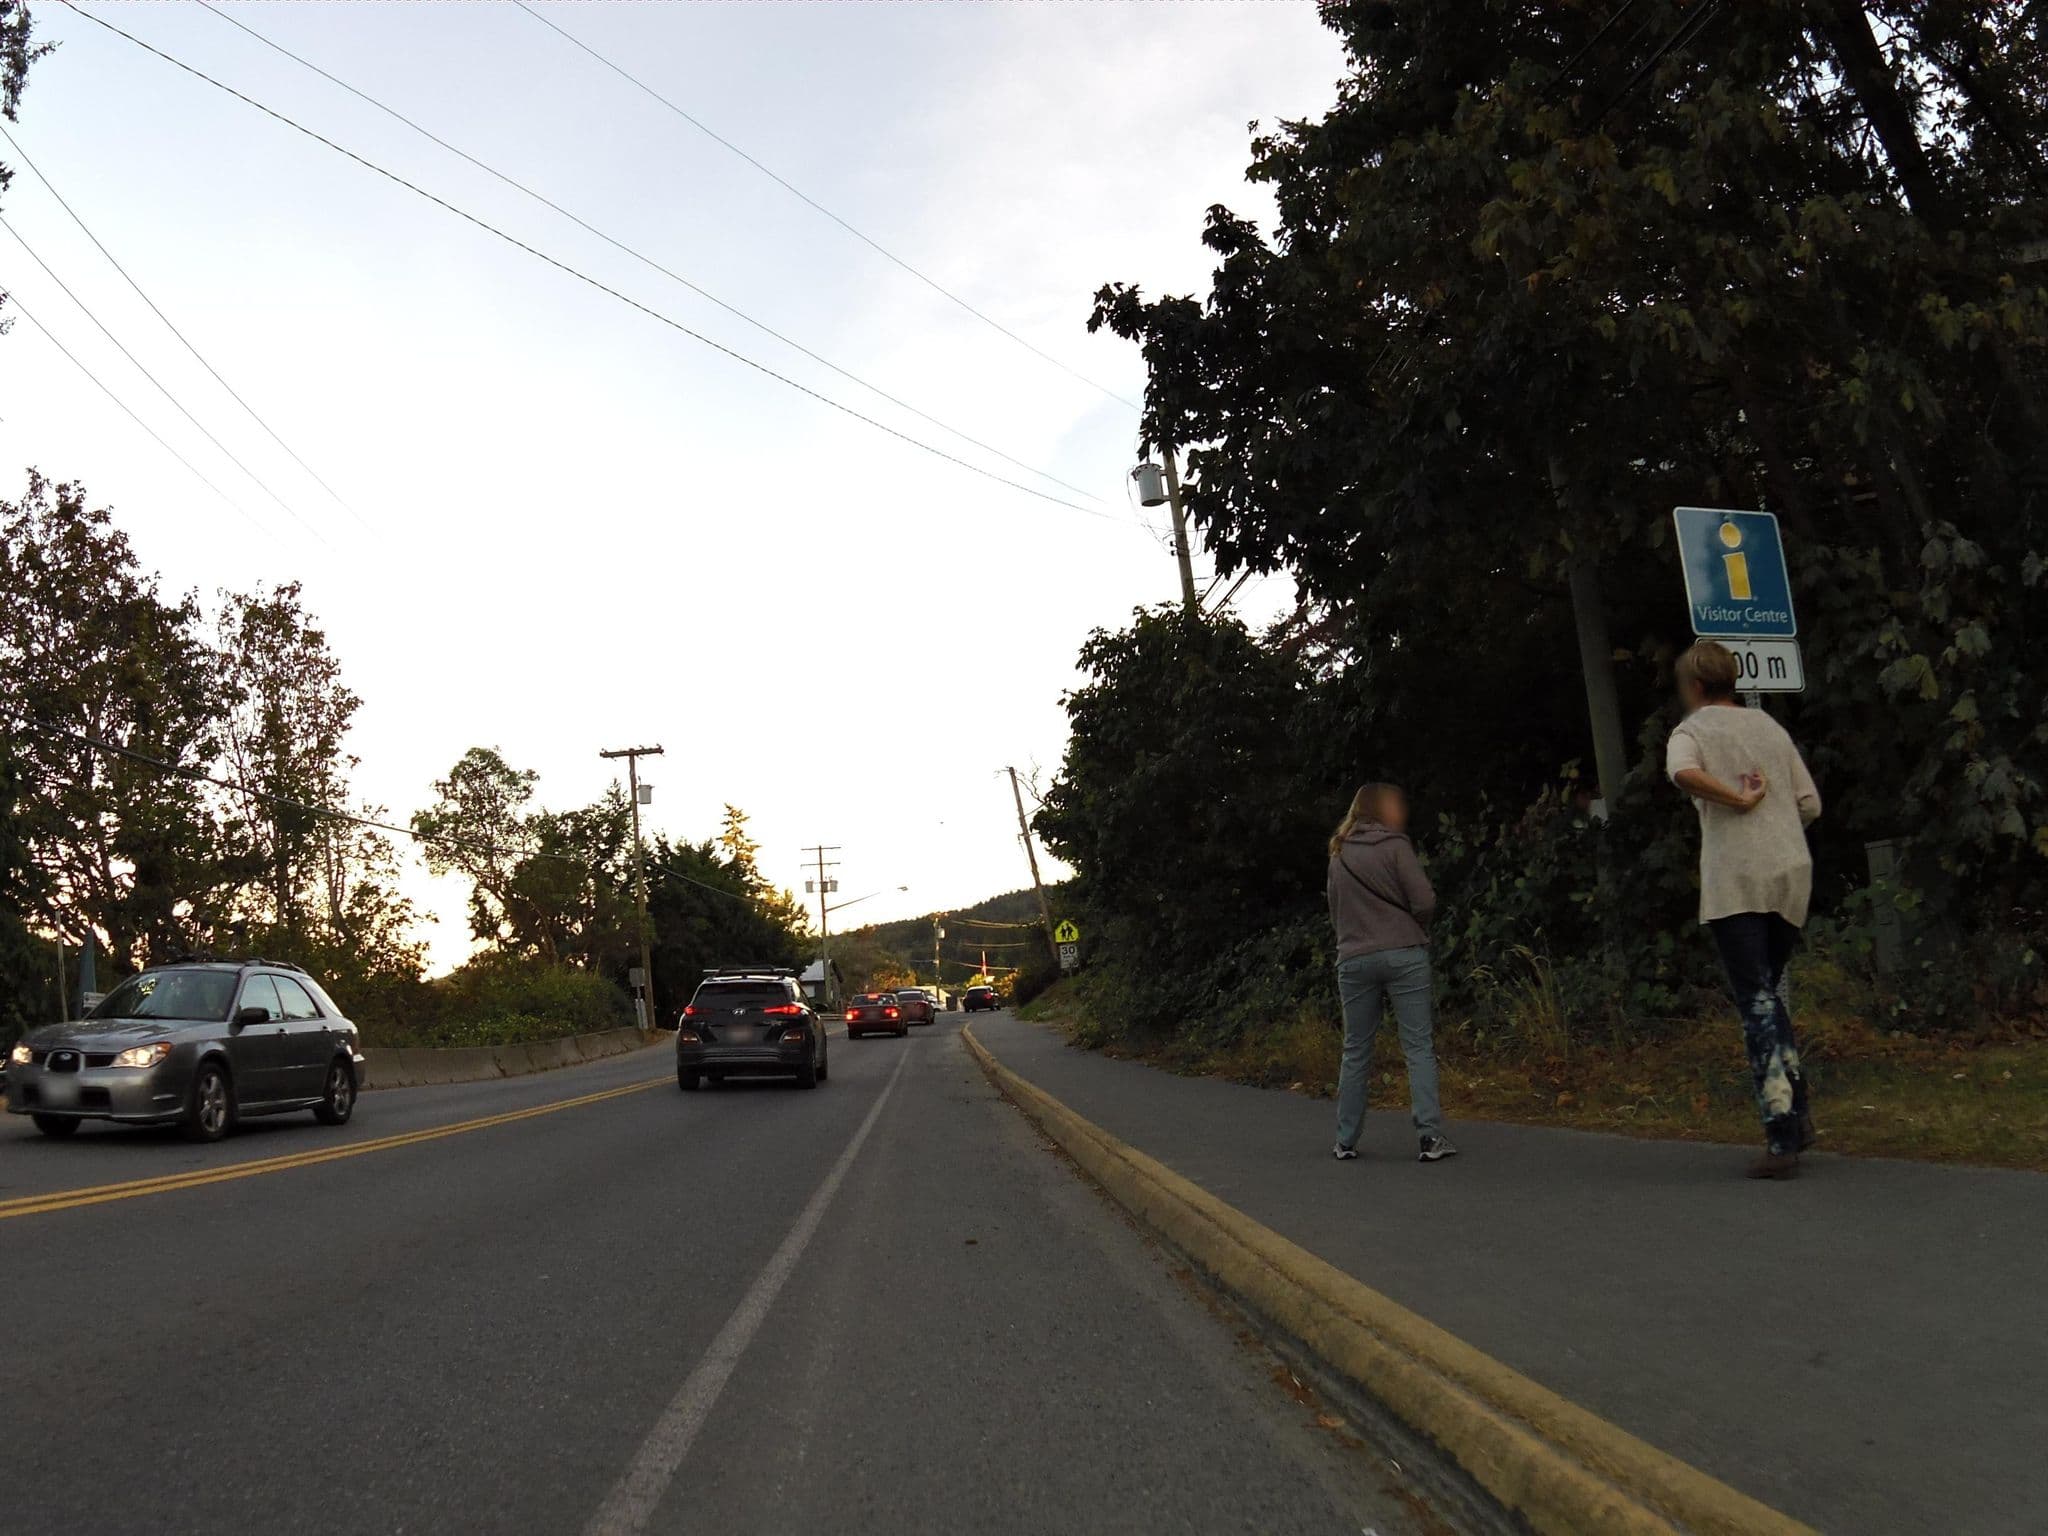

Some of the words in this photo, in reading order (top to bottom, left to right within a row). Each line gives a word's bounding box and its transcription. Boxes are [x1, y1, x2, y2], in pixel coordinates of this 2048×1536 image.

[1697, 606, 1741, 621] Visitor
[1745, 607, 1788, 623] Centre
[1767, 656, 1787, 679] m
[1062, 946, 1075, 954] 30
